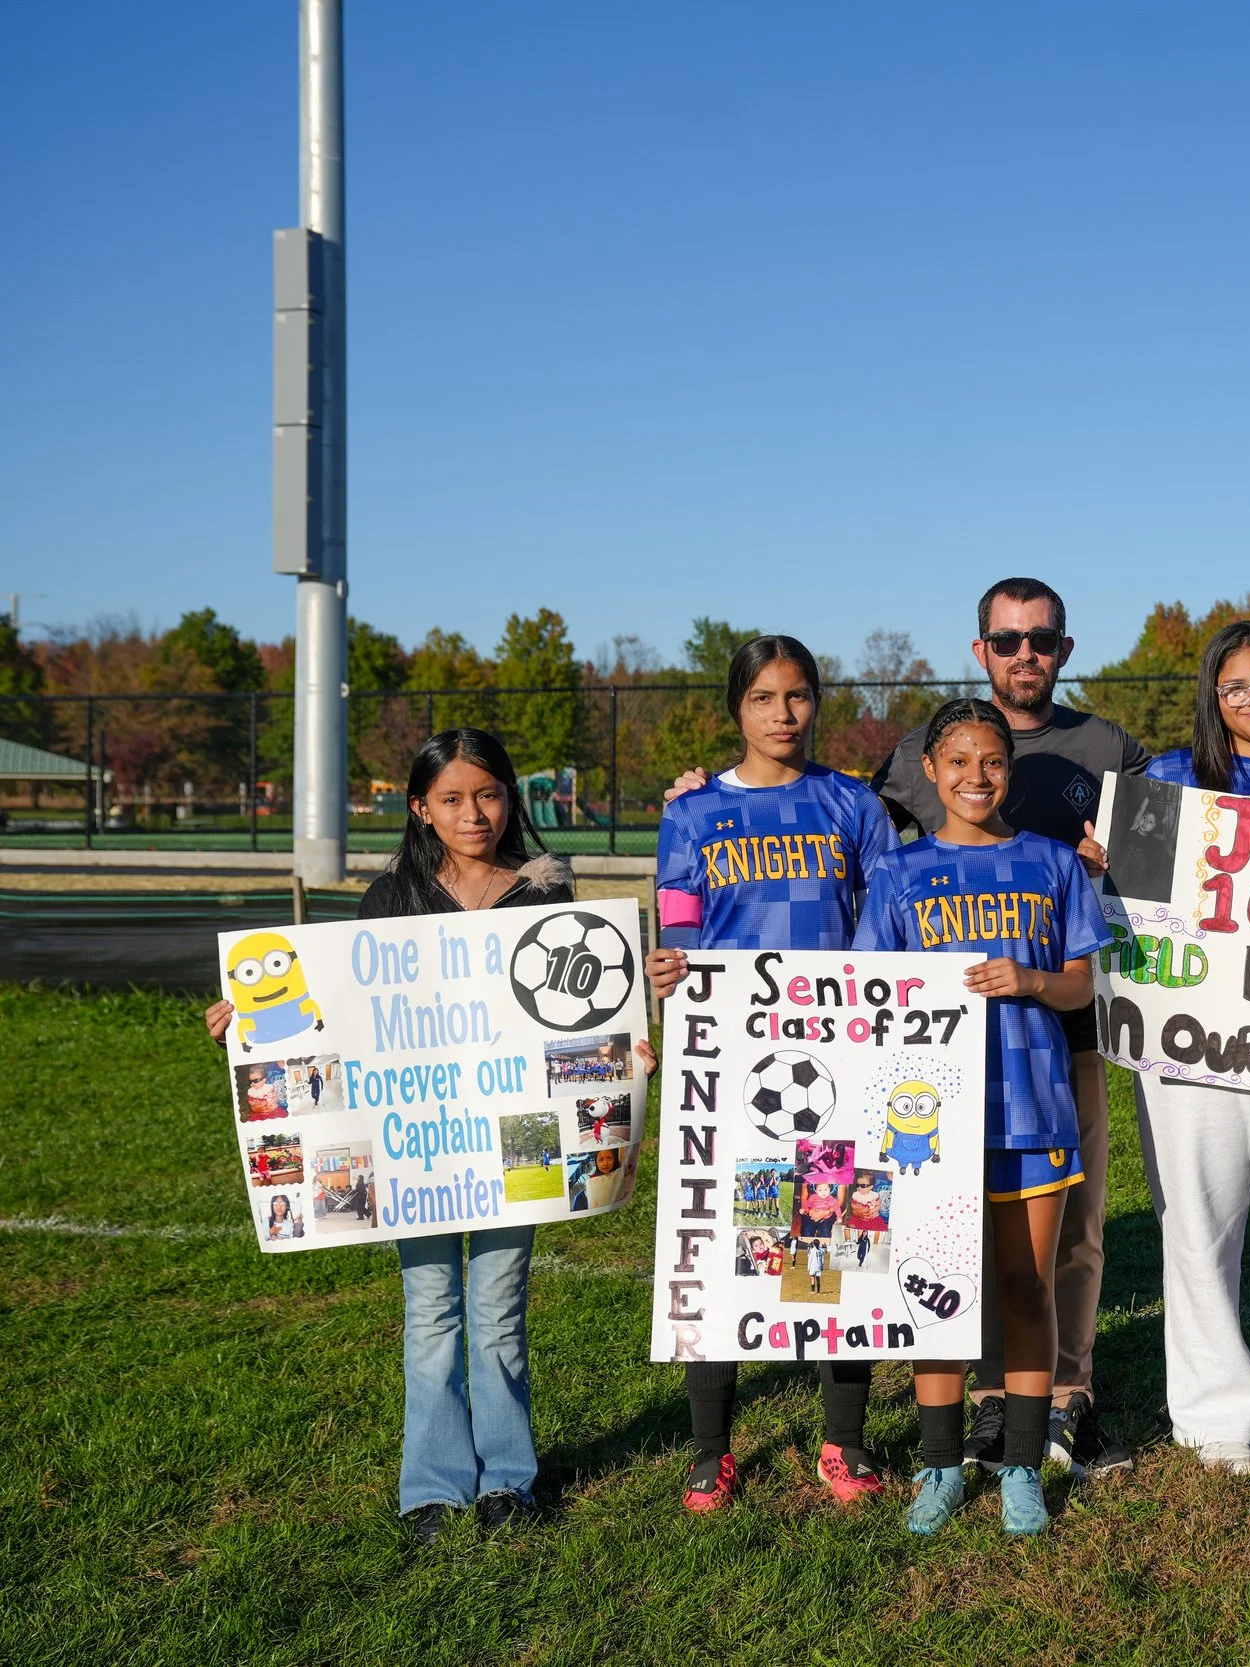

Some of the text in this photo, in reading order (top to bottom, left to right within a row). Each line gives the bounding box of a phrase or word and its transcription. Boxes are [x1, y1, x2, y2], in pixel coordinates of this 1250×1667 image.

[701, 833, 847, 890] KNIGHTS
[914, 891, 1055, 948] KNIGHTS
[351, 925, 503, 987] One in a
[547, 945, 602, 999] 10
[750, 952, 925, 1007] Senior
[372, 992, 501, 1052] Minion,
[847, 1008, 894, 1046] of
[344, 1055, 527, 1110] Forever our
[383, 1104, 493, 1171] Captain
[668, 964, 725, 1362] JENNIFER
[383, 1167, 504, 1228] Jennifer
[904, 1274, 961, 1319] #10
[738, 1308, 915, 1360] Captain
